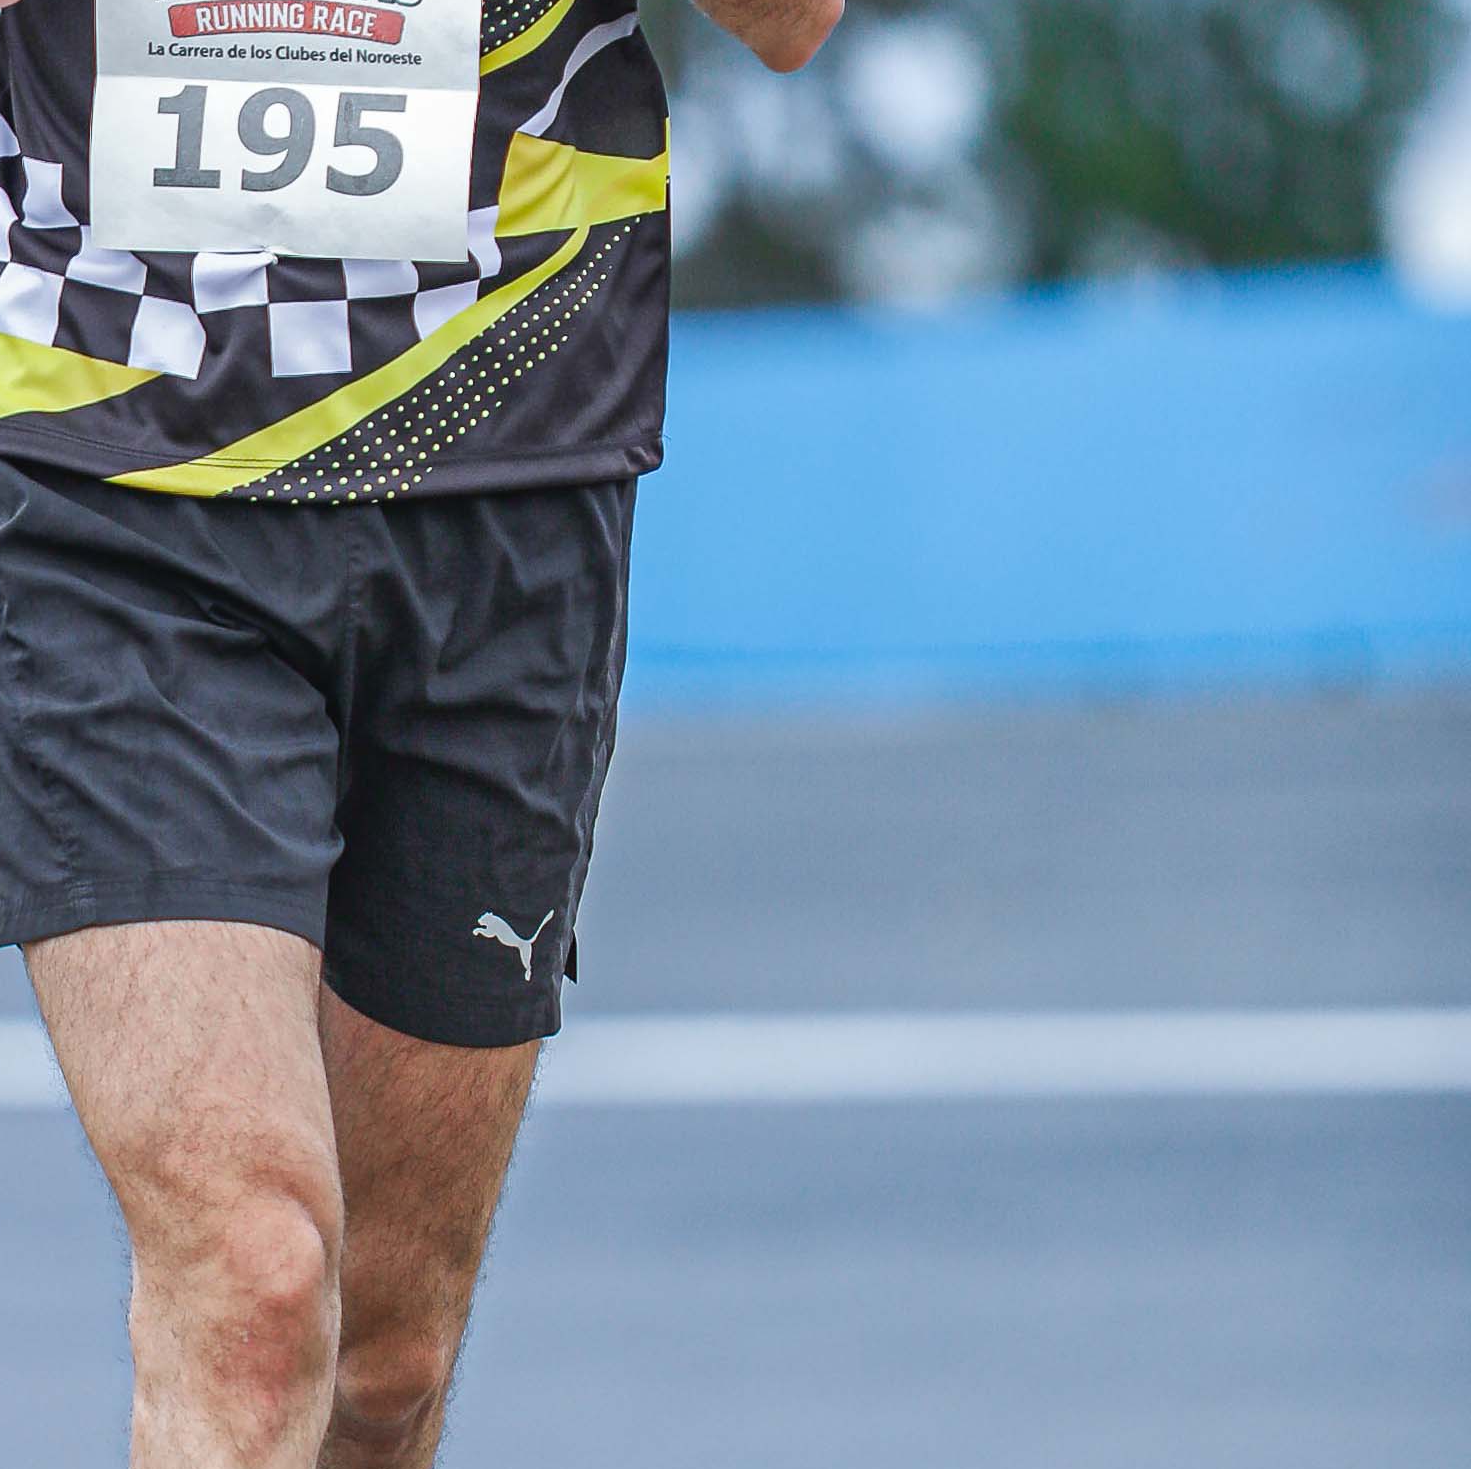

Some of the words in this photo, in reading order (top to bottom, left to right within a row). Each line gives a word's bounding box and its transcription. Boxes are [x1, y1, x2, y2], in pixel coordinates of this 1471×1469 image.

[194, 1, 305, 33] RUNNING
[312, 3, 377, 38] RACE
[148, 42, 165, 57] La
[168, 43, 224, 59] Carrera
[228, 44, 247, 59] de
[251, 45, 272, 60] los
[275, 46, 326, 62] Clubes
[329, 48, 353, 63] del
[356, 49, 423, 66] Noroeste
[152, 84, 409, 197] 195
